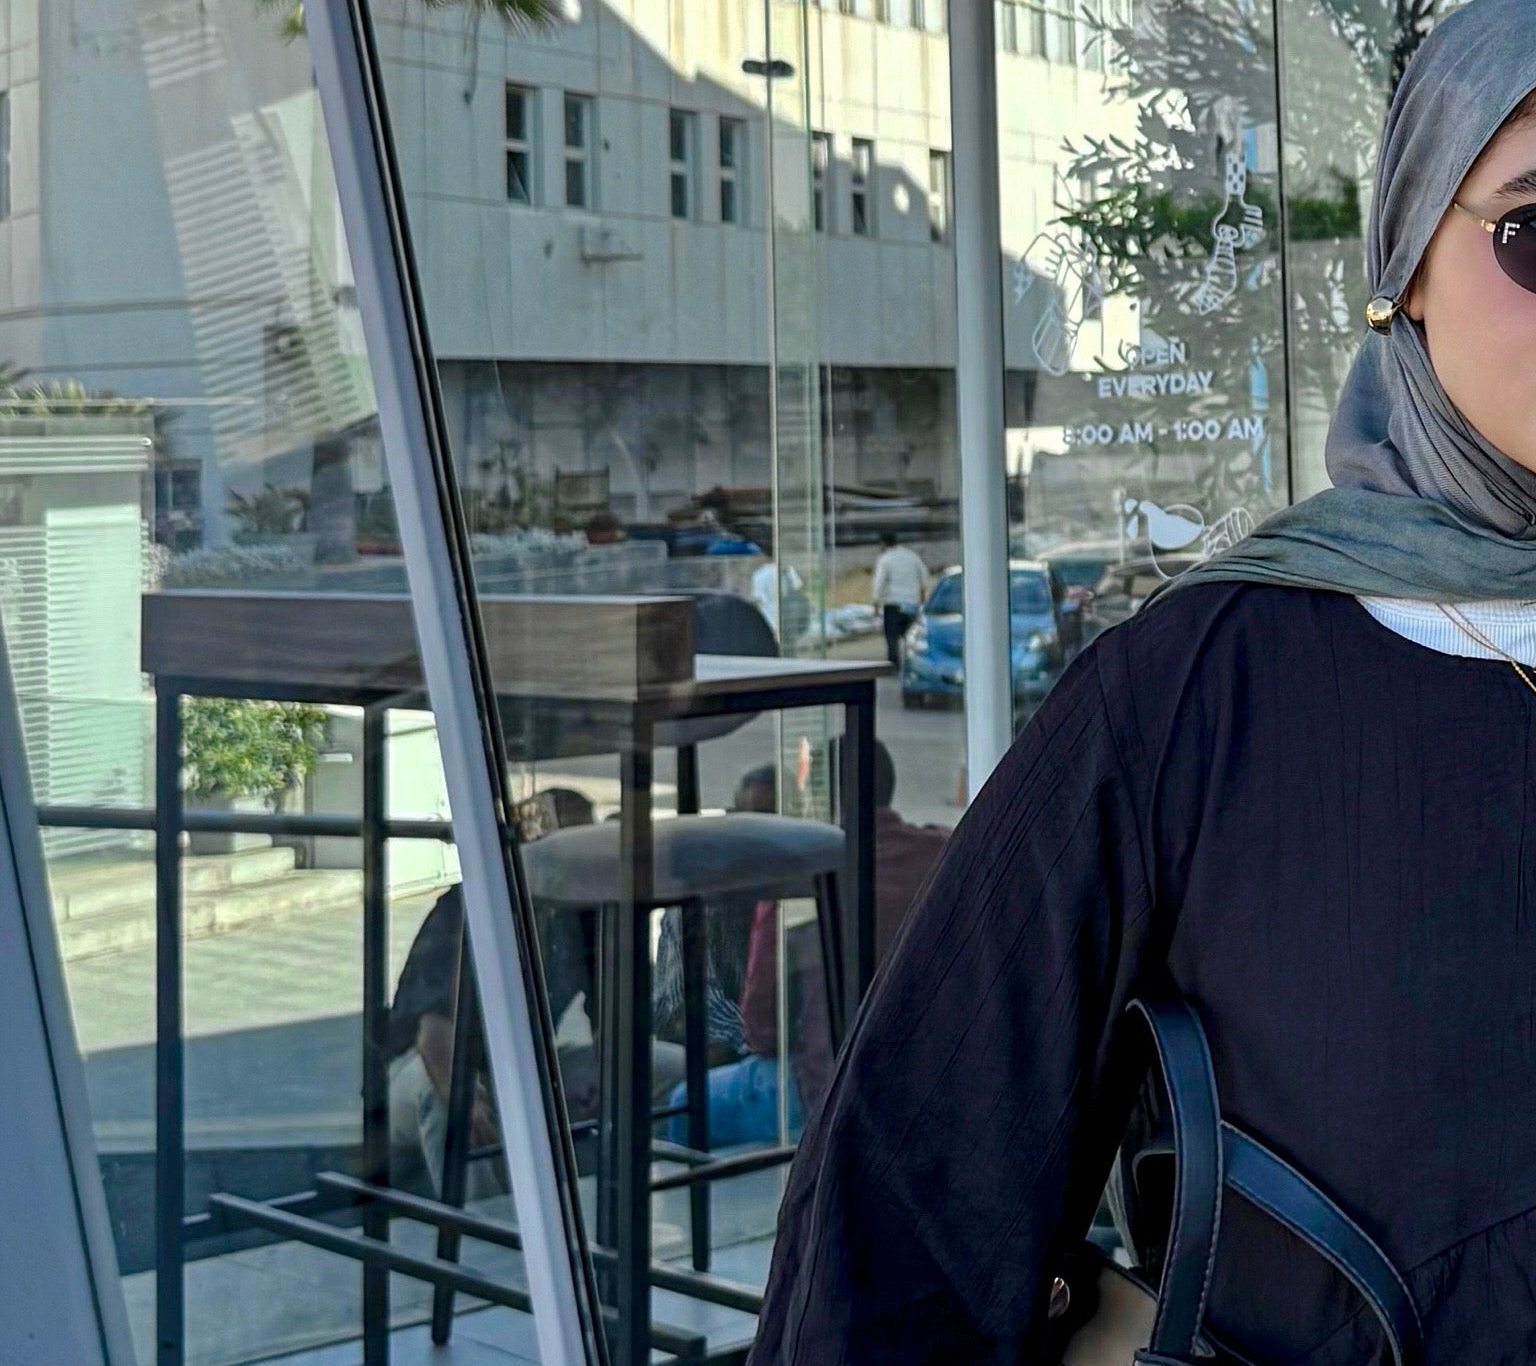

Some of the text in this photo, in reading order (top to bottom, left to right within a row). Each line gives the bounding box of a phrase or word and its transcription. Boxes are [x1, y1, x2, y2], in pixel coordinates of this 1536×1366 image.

[1126, 341, 1186, 366] OPEN
[1099, 371, 1214, 398] EVERYDAY
[1118, 422, 1153, 444] AM
[1173, 419, 1221, 441] 1:00
[1227, 417, 1265, 440] AM
